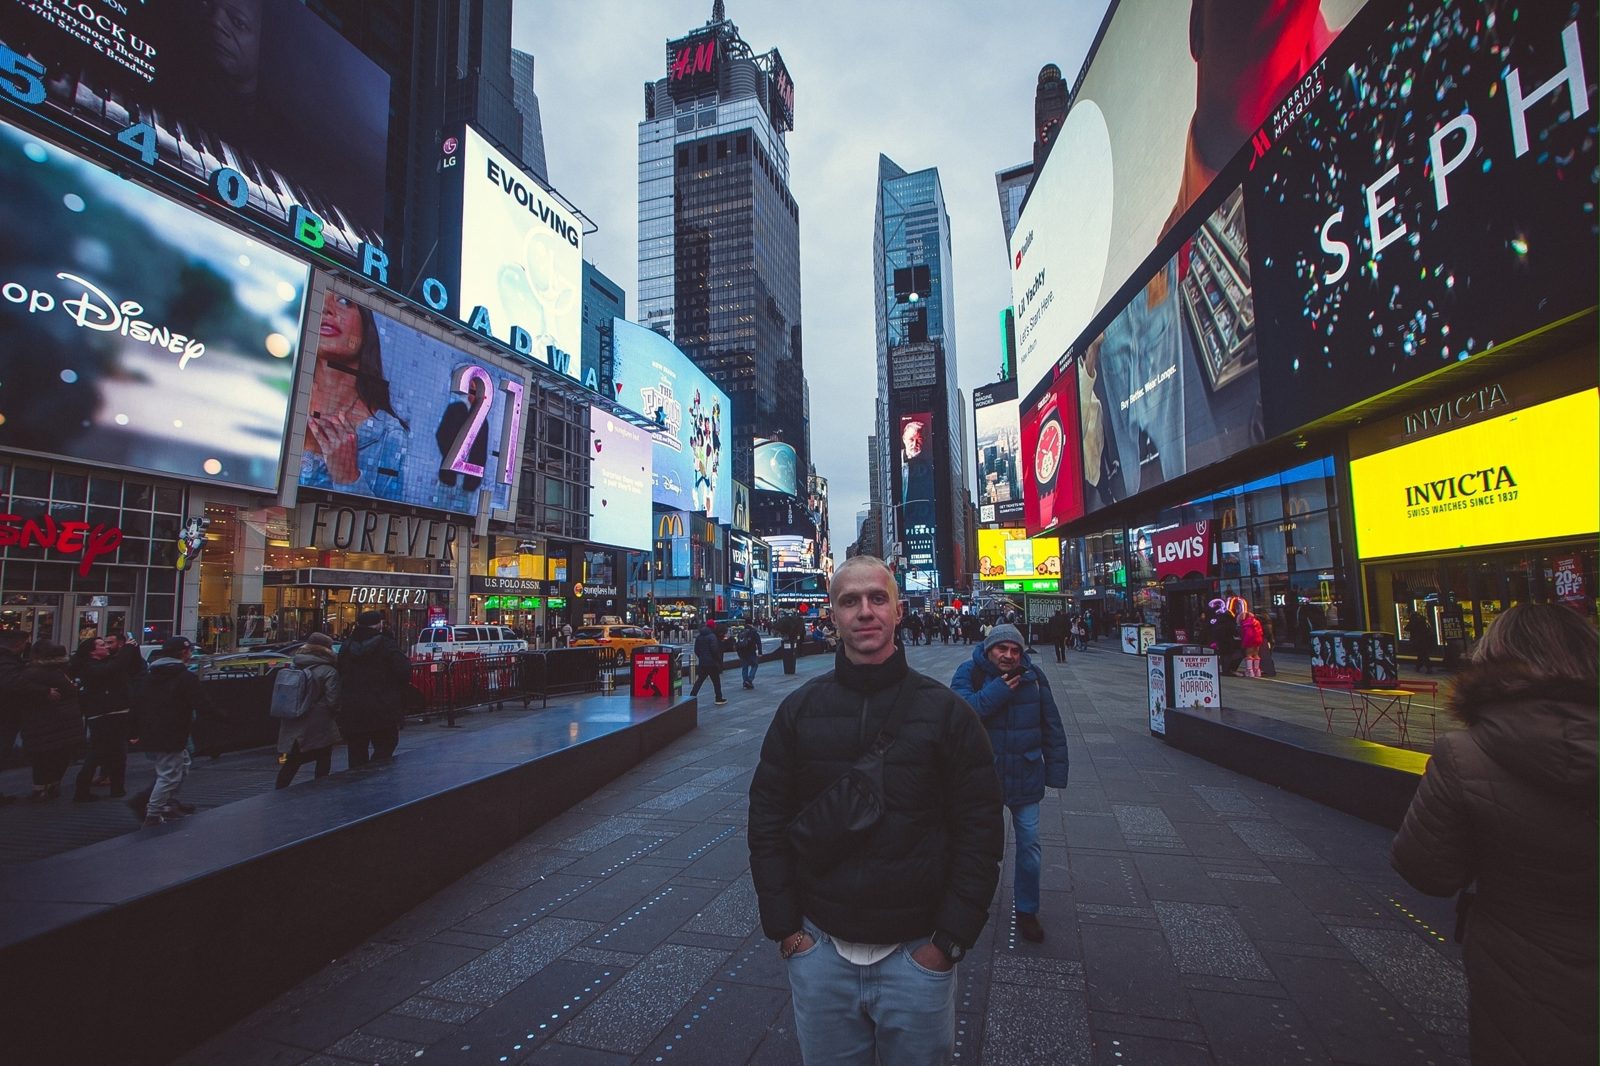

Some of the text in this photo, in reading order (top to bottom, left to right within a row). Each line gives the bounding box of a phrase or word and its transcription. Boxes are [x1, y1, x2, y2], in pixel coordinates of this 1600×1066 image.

[28, 3, 154, 83] 47th Street & Broadway
[42, 0, 156, 73] Barrymore Theatre
[130, 34, 156, 58] UP
[669, 38, 715, 81] H&M
[1273, 57, 1328, 125] MARRIOTT
[1274, 80, 1322, 138] MARQUIS
[443, 156, 456, 168] LG
[1320, 21, 1590, 285] SEPH
[487, 157, 579, 249] EVOLVING
[1120, 399, 1129, 410] Buy
[1404, 383, 1509, 436] INVICTA
[449, 365, 524, 485] 21
[1404, 465, 1517, 507] INVICTA
[1407, 491, 1519, 518] SWISS WATCHES SINCE 1837
[309, 503, 457, 561] FOREVER
[484, 578, 498, 587] U.S.
[499, 579, 519, 588] POLO
[583, 586, 606, 598] sunglass
[1554, 570, 1583, 585] 20%
[1556, 583, 1580, 596] OFF
[350, 587, 426, 604] FOREVER 21
[1180, 670, 1198, 679] LITTLE
[1180, 681, 1213, 695] HORRORS
